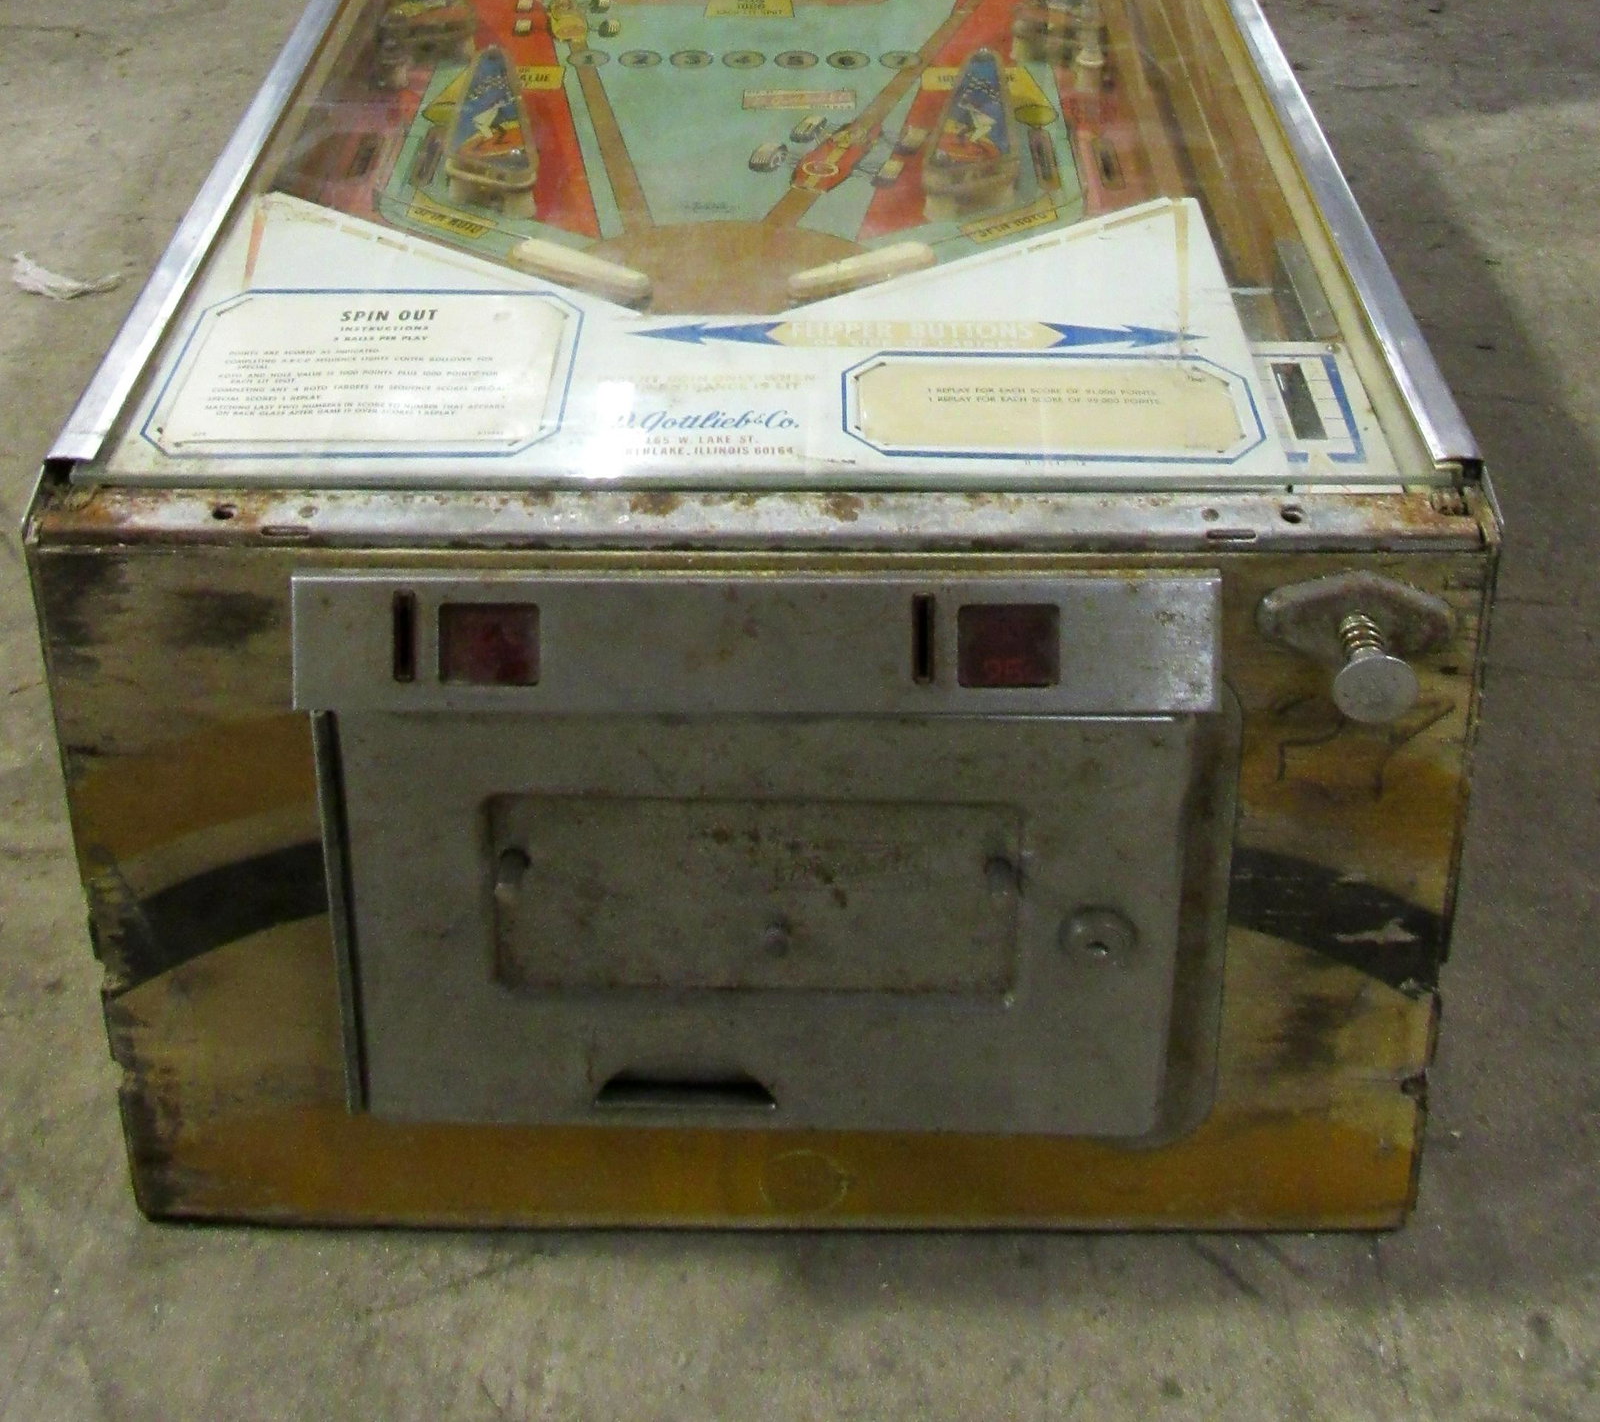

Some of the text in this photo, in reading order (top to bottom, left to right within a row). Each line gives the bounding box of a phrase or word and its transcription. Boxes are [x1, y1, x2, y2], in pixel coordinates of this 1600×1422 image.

[340, 309, 439, 322] SPIN OUT
[791, 322, 1034, 339] FLIPPER BUTTONS
[639, 410, 752, 433] Gottlieb
[764, 410, 800, 428] Co.
[679, 435, 694, 444] W.
[698, 435, 732, 444] LAKE
[739, 435, 760, 444] ST.
[624, 446, 794, 456] RTHLAKE, ILLINOIS 60164
